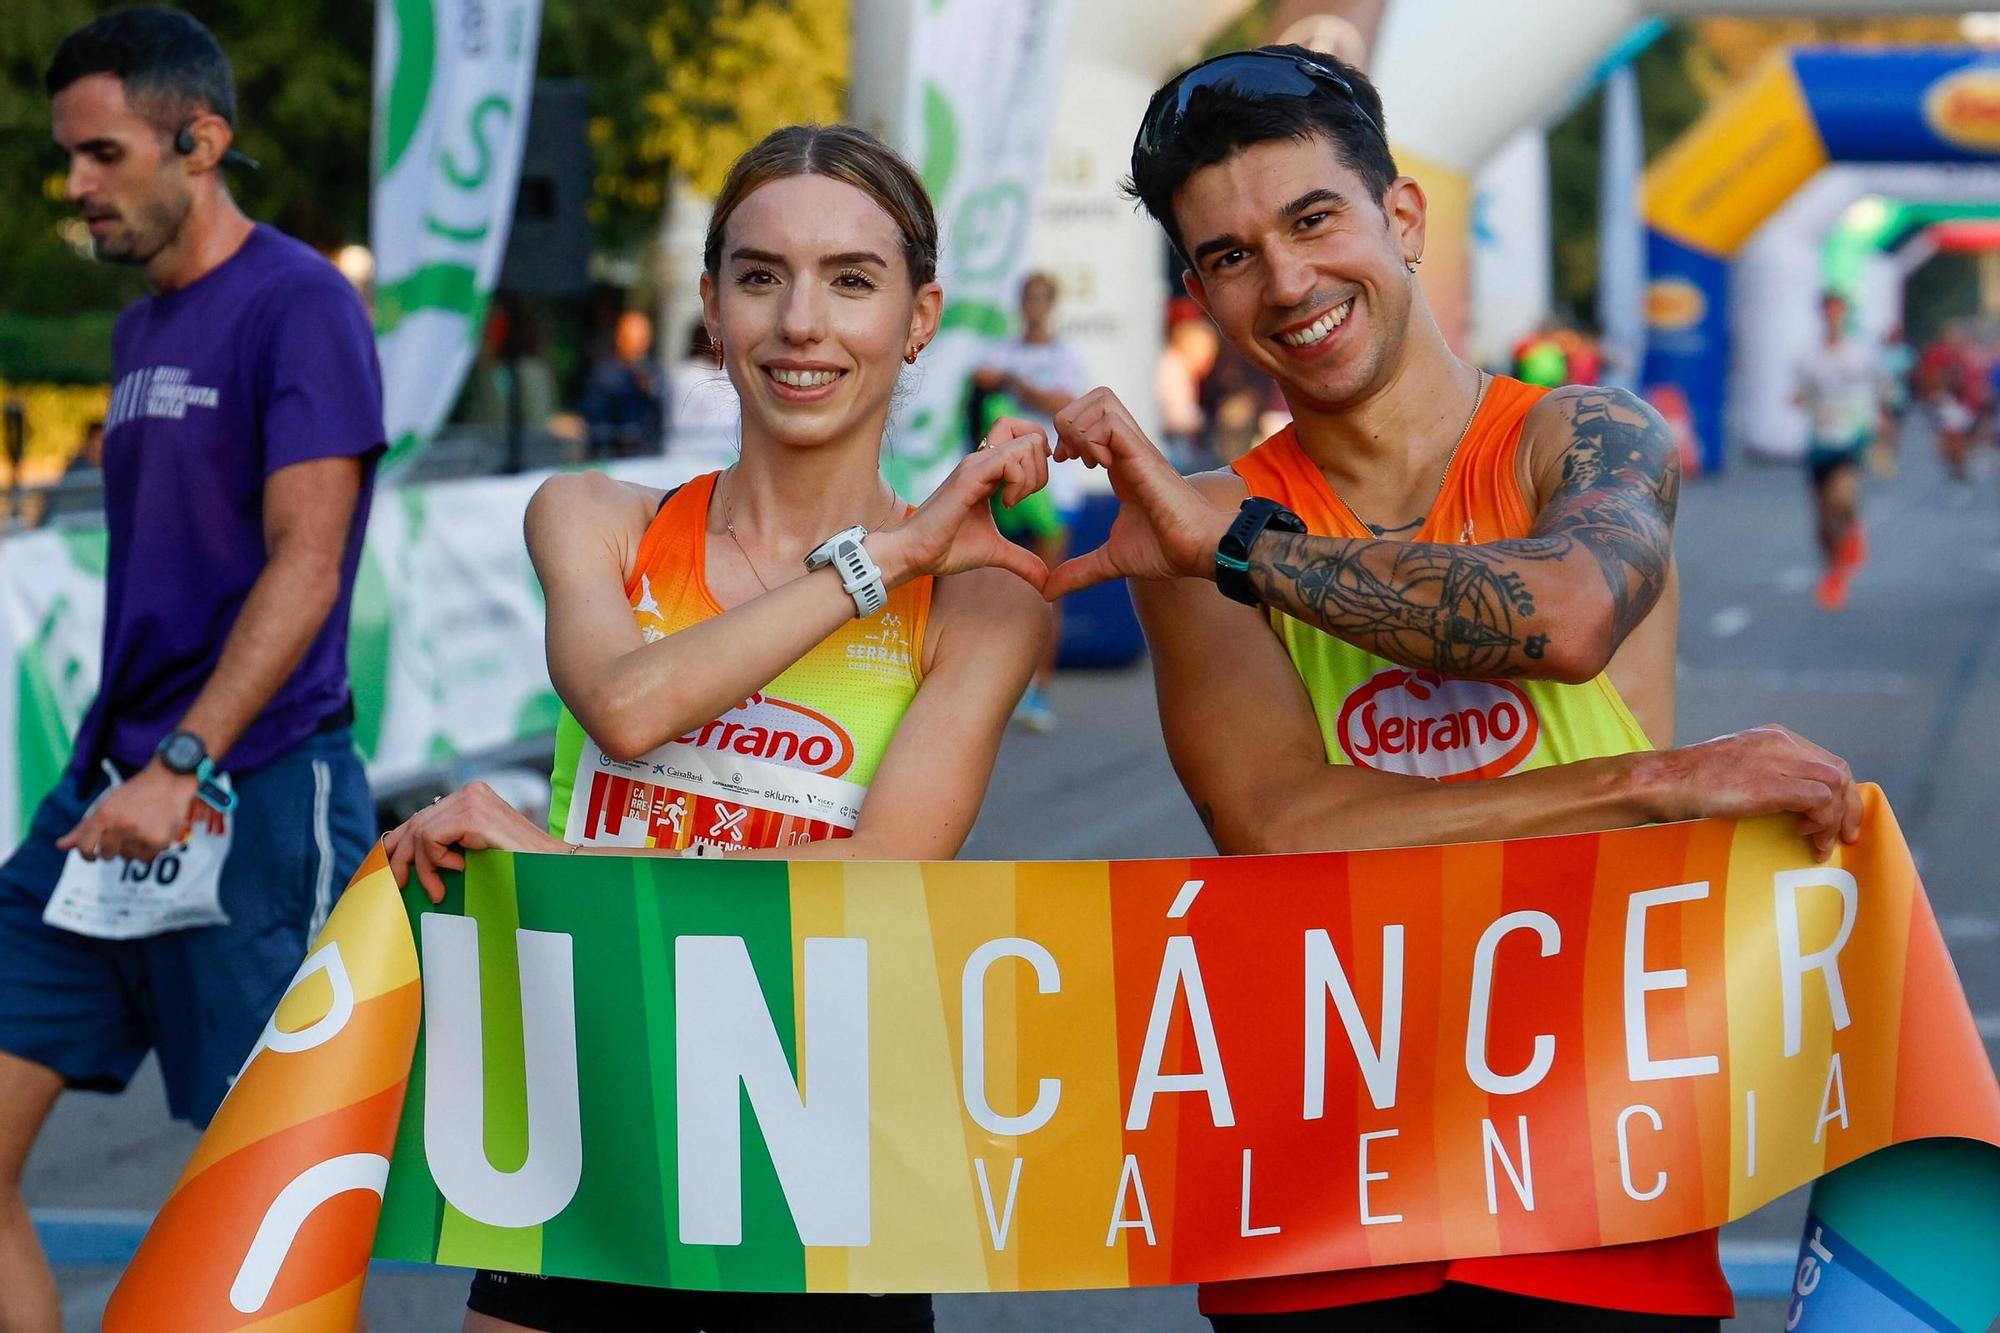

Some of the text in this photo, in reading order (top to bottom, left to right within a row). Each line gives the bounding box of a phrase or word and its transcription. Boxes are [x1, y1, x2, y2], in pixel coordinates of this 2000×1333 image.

[674, 719, 834, 766] rrano
[1354, 702, 1520, 757] Serrano
[633, 788, 644, 800] CA
[666, 766, 704, 782] CaixaBank
[961, 867, 1859, 1136] CÁNCER
[974, 1053, 1849, 1251] VALENCIA
